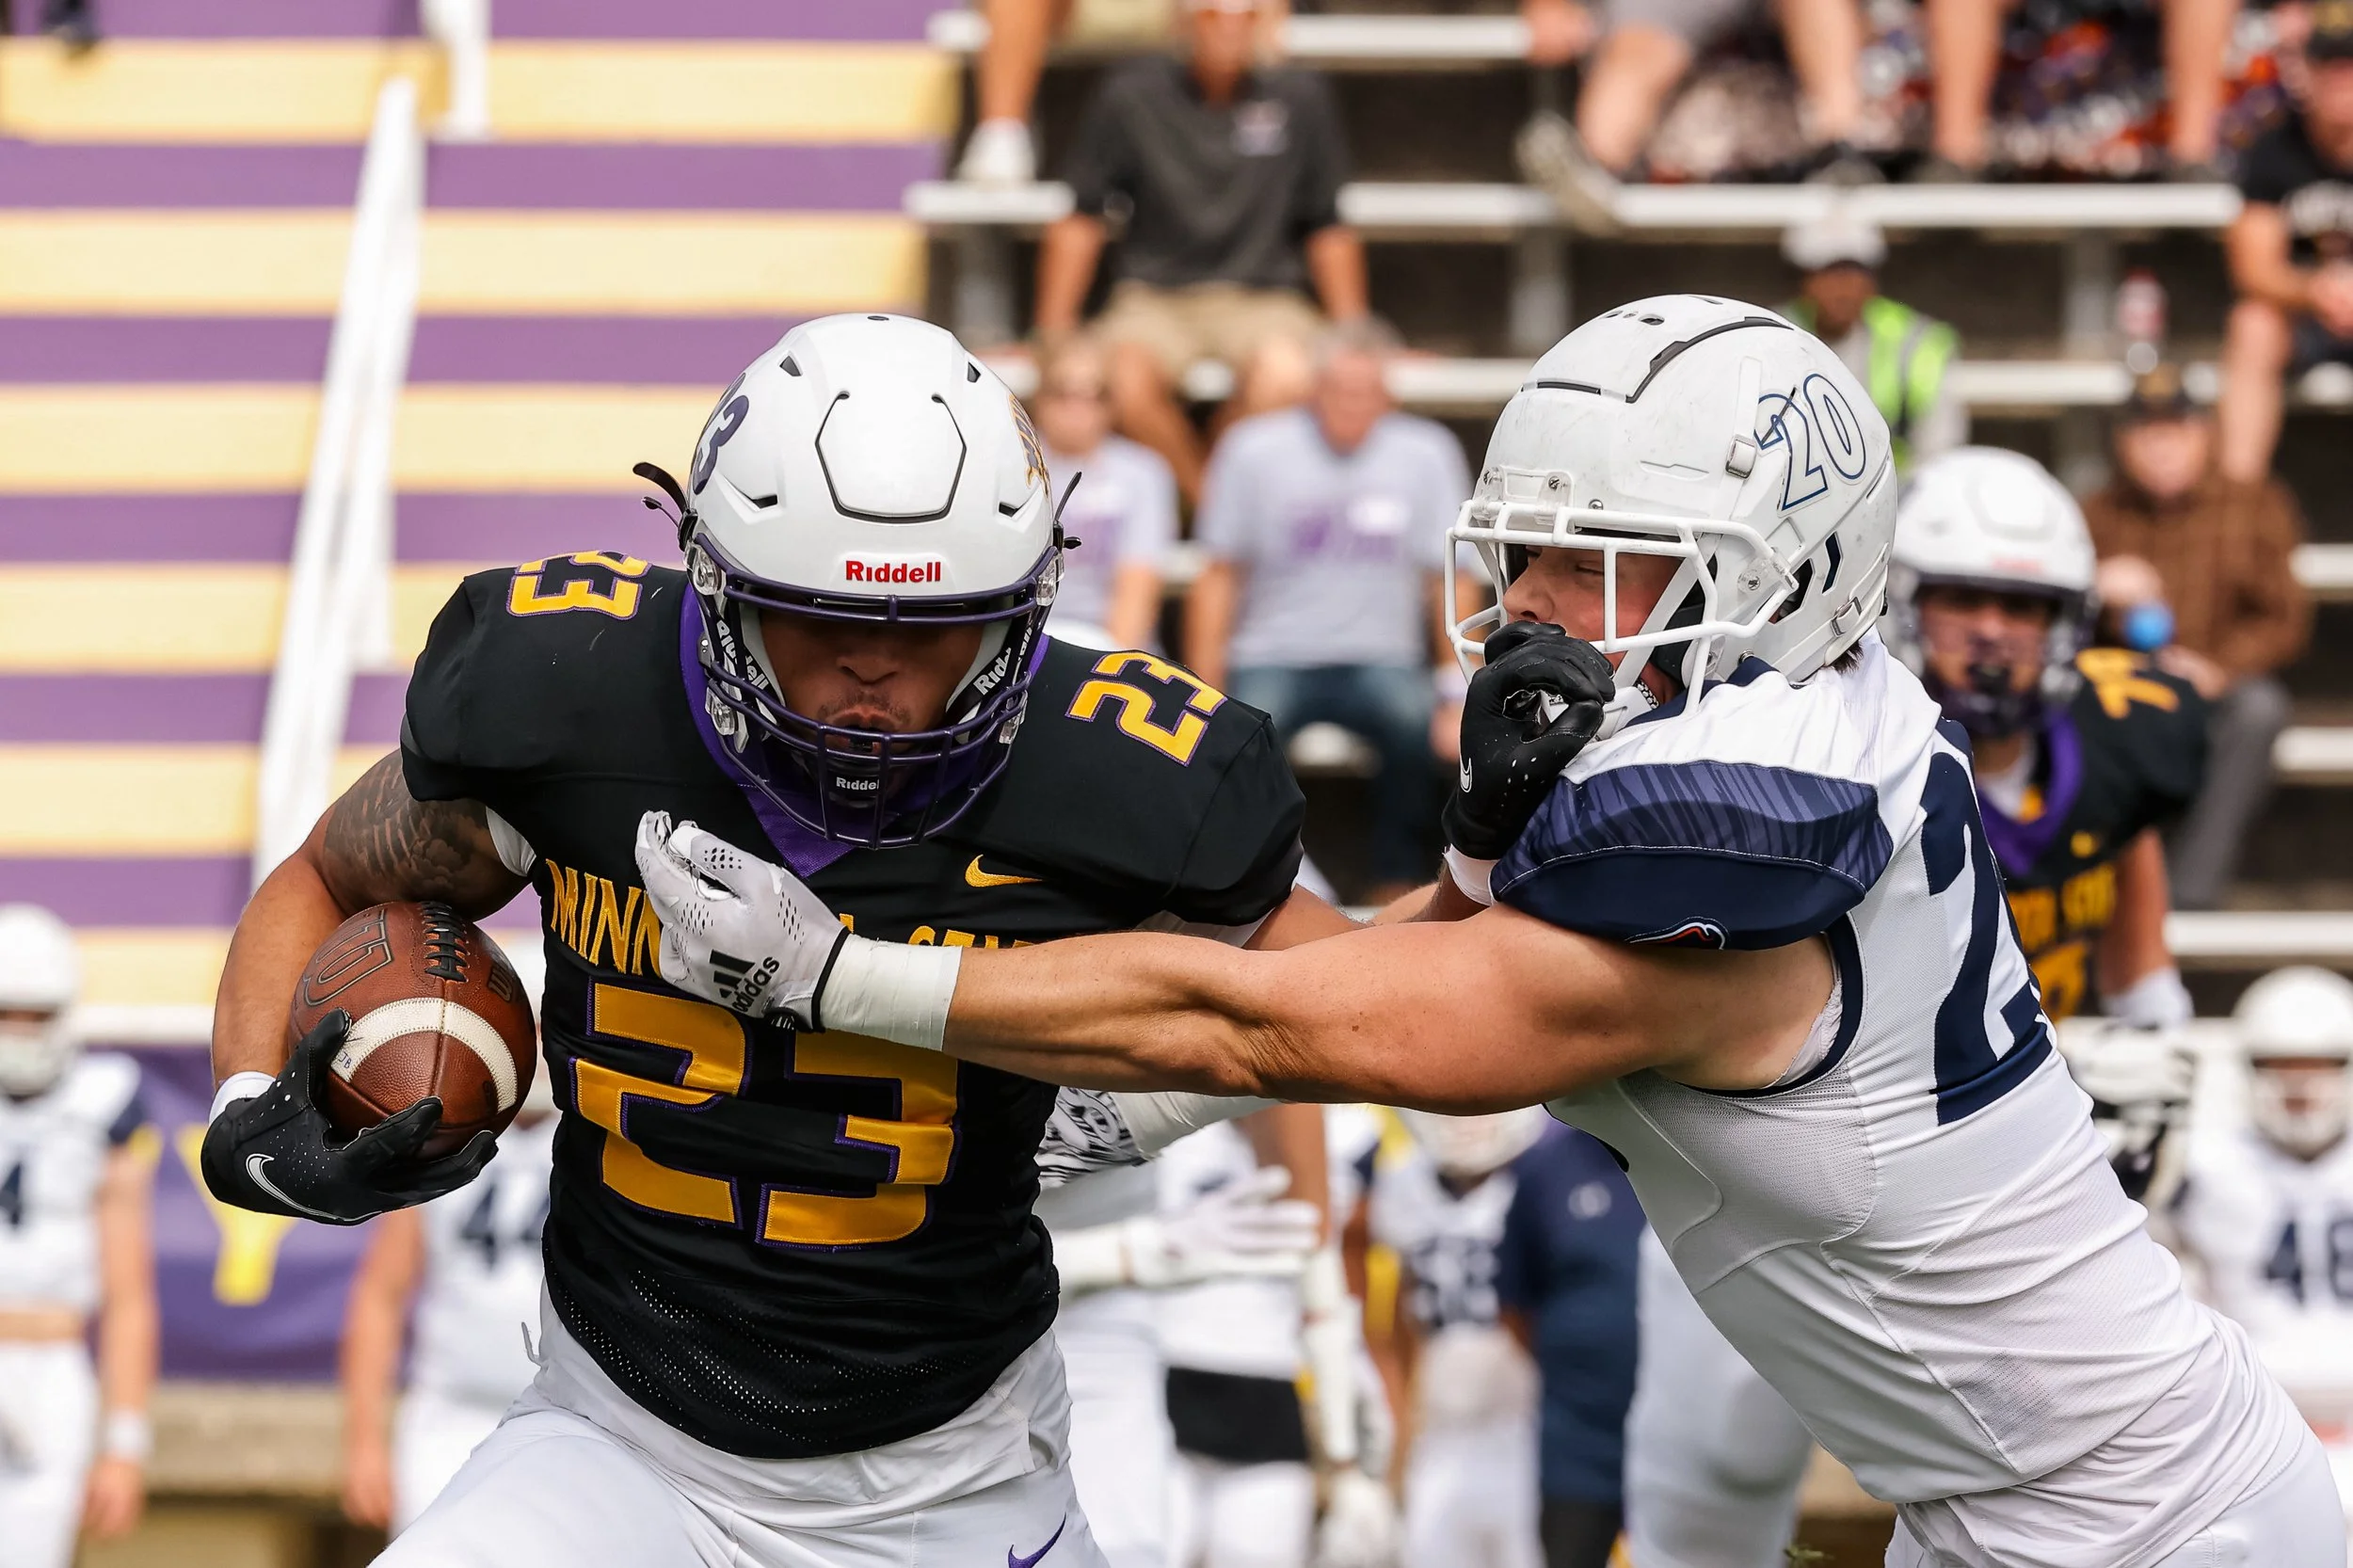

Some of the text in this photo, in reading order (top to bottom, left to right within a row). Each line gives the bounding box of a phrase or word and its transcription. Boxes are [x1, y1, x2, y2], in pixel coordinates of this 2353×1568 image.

[1753, 373, 1866, 511] 20
[845, 560, 941, 583] Riddell
[1064, 652, 1228, 767] 23
[731, 956, 780, 1013] adidas
[1921, 750, 2054, 1128] 2
[568, 975, 963, 1253] 23
